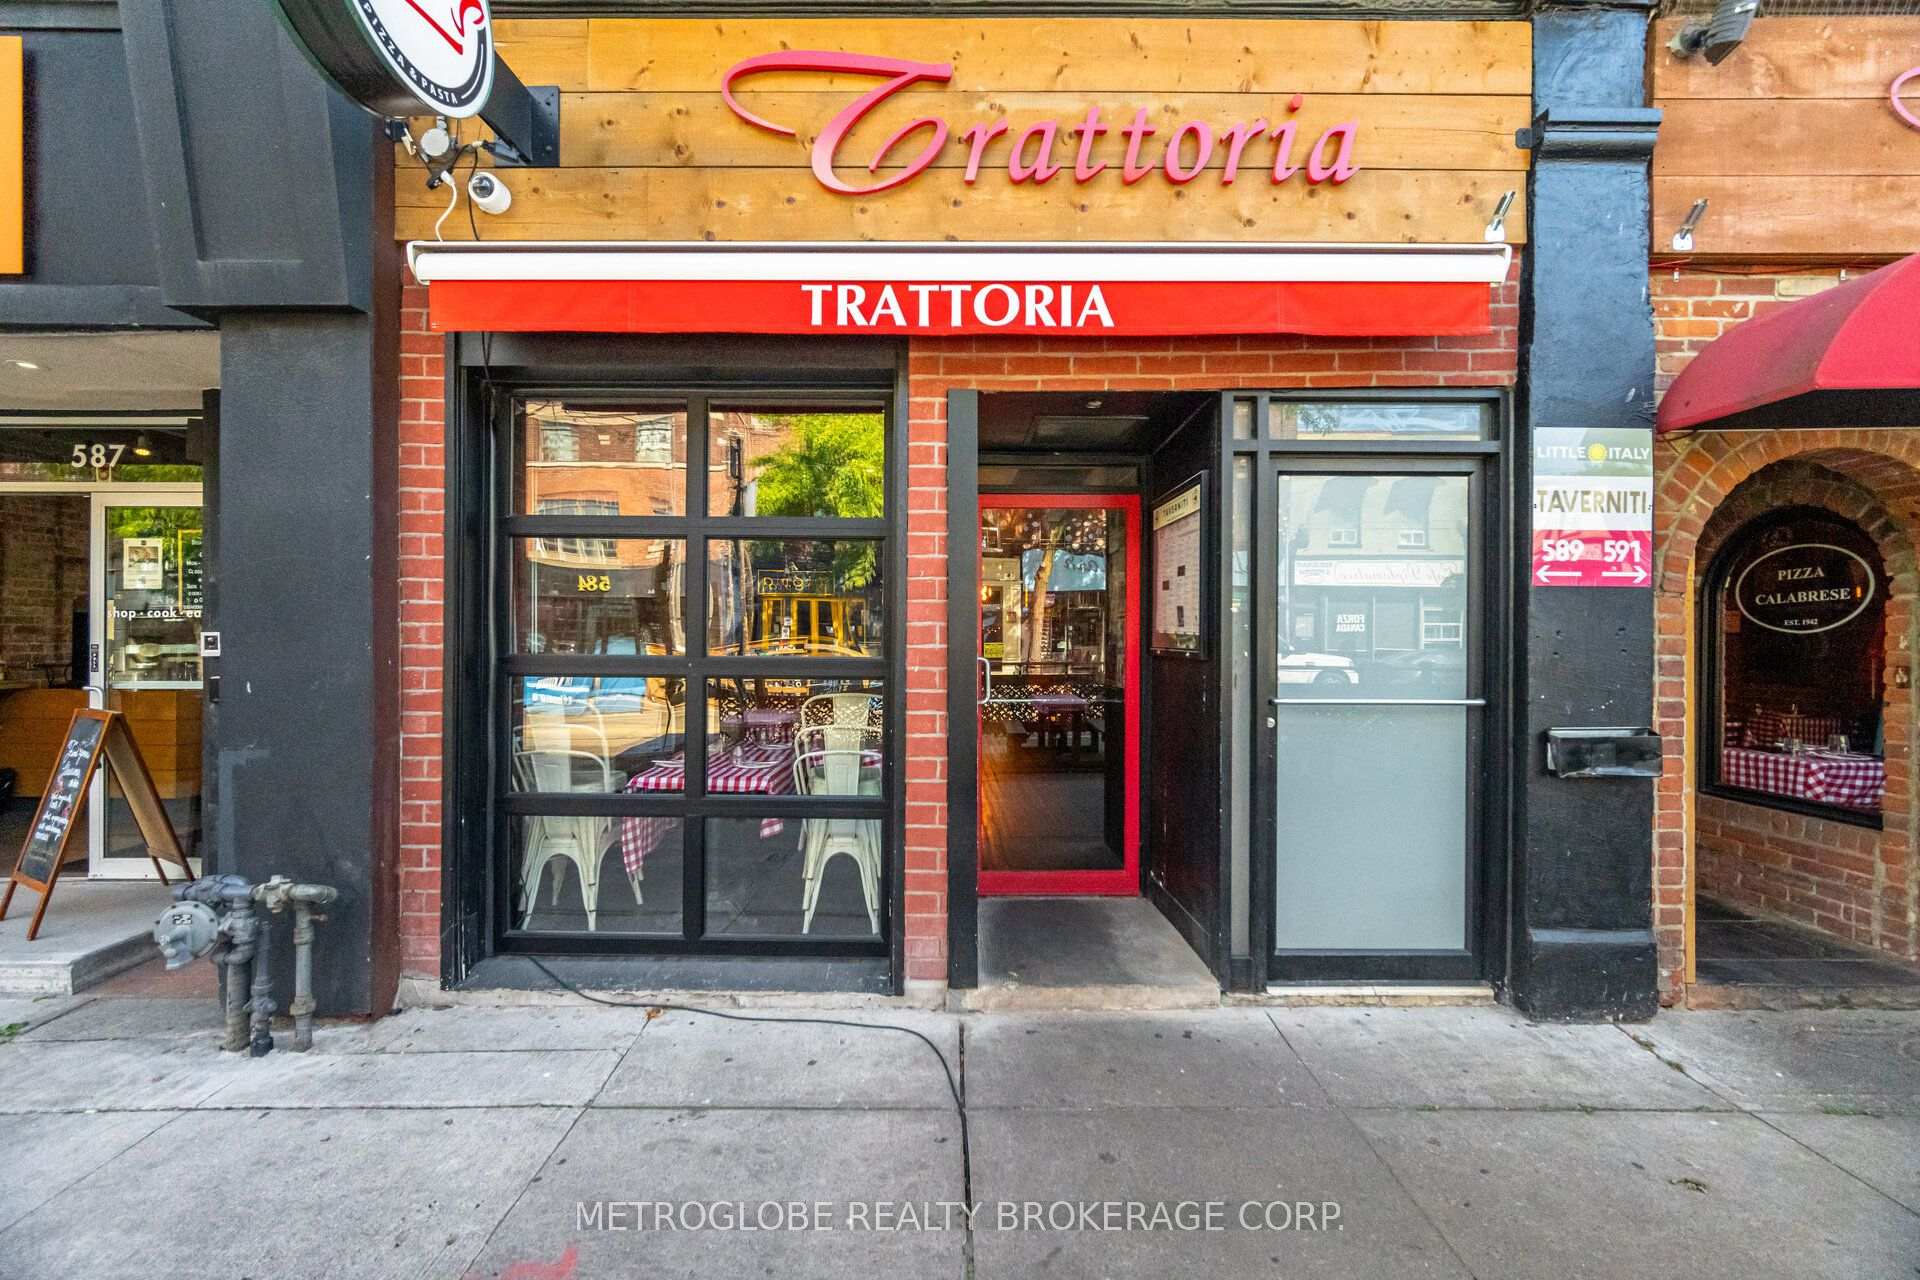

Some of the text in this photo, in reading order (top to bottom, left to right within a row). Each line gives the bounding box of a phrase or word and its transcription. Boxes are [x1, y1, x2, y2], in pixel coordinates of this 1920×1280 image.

[363, 3, 405, 67] PIZZA
[409, 67, 418, 81] &
[421, 77, 458, 104] PASTA
[722, 50, 1361, 195] Trattoria
[801, 283, 1115, 328] TRATTORIA
[71, 443, 126, 468] 587
[1536, 446, 1649, 460] LITTLE ITALY
[1536, 490, 1647, 514] TAVERNITI
[1542, 539, 1641, 562] 589 591
[1777, 566, 1824, 581] PIZZA
[1755, 588, 1850, 605] CALABRESE
[107, 606, 137, 621] shop
[147, 606, 177, 618] cook
